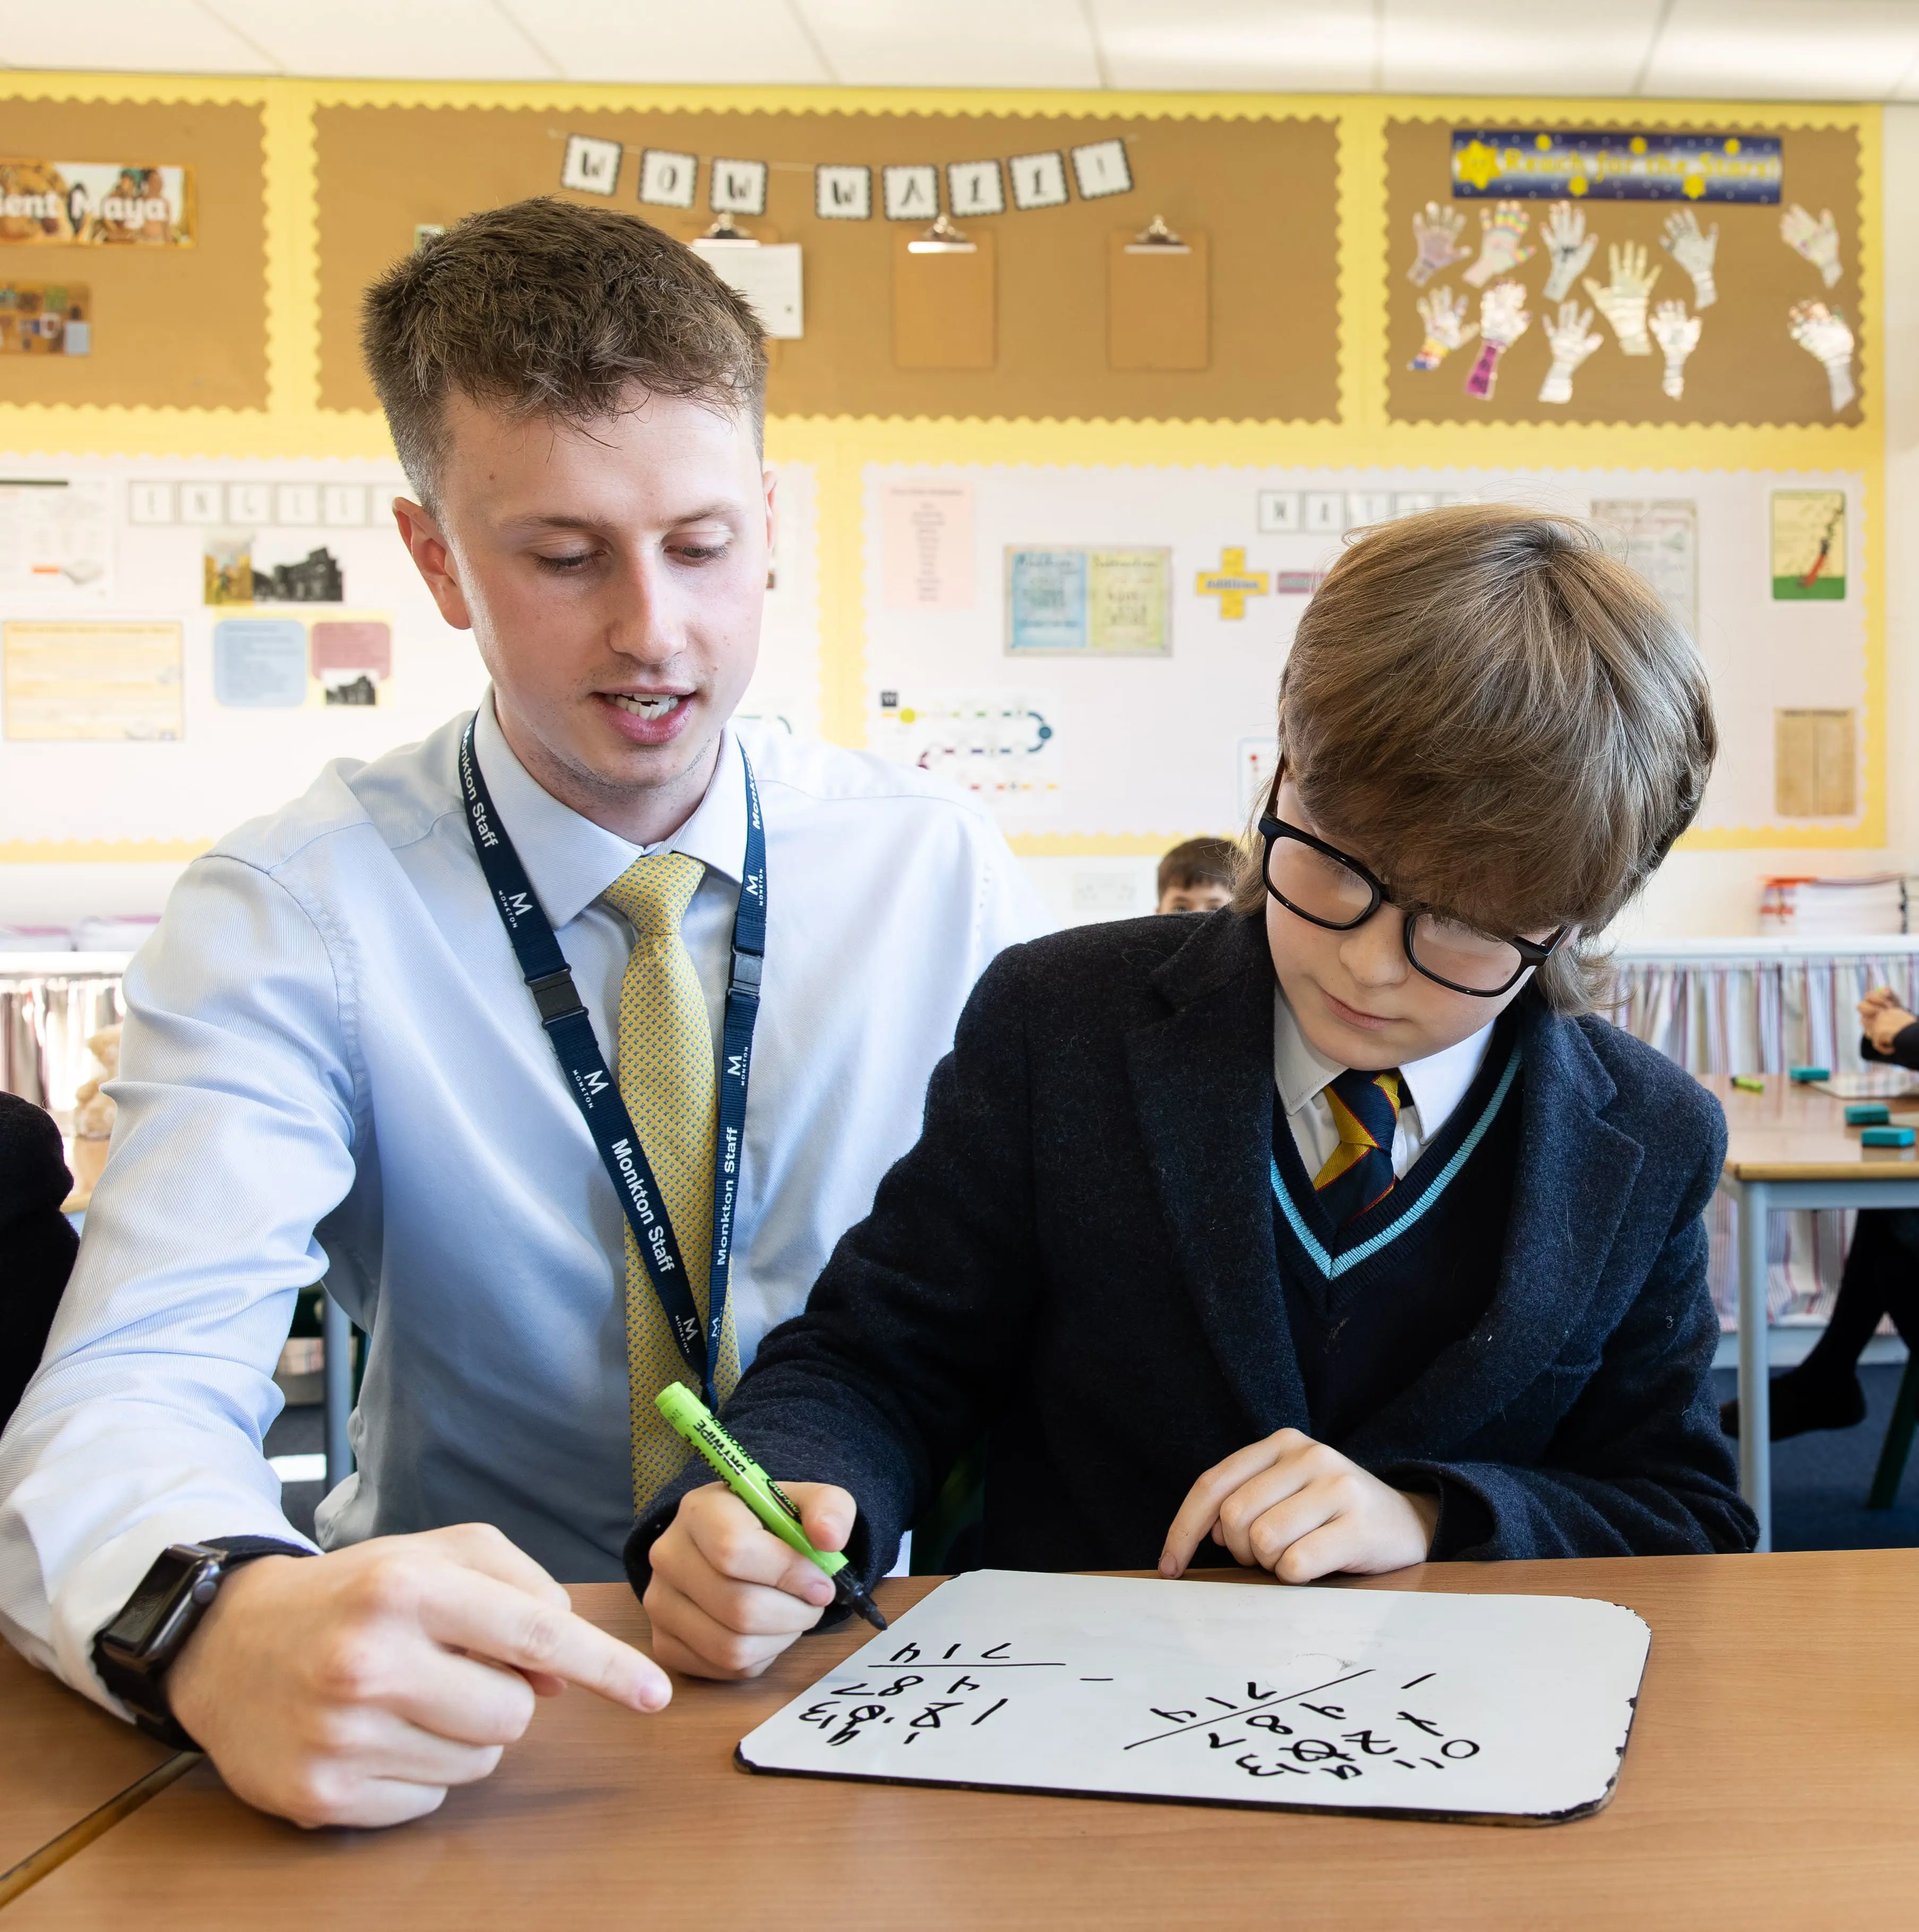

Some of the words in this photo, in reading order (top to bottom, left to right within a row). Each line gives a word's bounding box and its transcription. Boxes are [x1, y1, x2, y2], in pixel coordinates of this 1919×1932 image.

[580, 149, 752, 201] WOW
[1504, 148, 1583, 173] Reach
[1596, 150, 1635, 183] for
[1646, 152, 1686, 174] the
[472, 802, 498, 848] Staff
[509, 891, 533, 917] M
[746, 874, 759, 897] M
[498, 890, 518, 929] MONKTON
[584, 1069, 609, 1095] M
[726, 1054, 743, 1077] M
[571, 1069, 594, 1110] MONKTON
[724, 1126, 738, 1174] Staff
[611, 1138, 655, 1225] Monkton
[647, 1225, 675, 1273] Staff
[717, 1179, 734, 1266] Monkton
[683, 1317, 699, 1341] M
[692, 1419, 747, 1476] DRYWIPE
